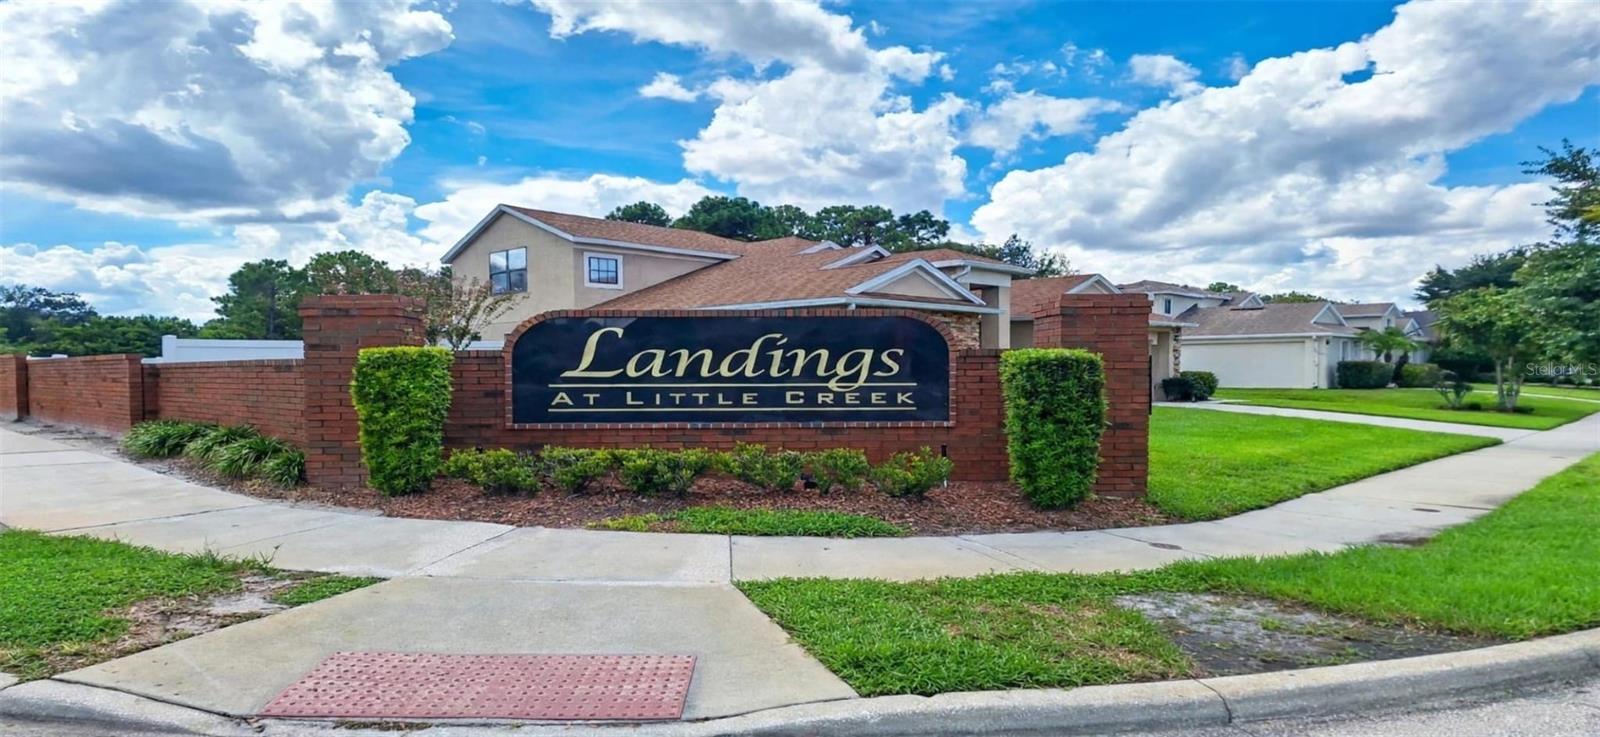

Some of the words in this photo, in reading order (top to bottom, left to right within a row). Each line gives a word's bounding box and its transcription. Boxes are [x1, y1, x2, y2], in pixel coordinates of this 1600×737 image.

[560, 327, 904, 391] Landings
[551, 392, 600, 405] AT
[626, 391, 758, 405] LITTLE
[785, 391, 914, 404] CREEK
